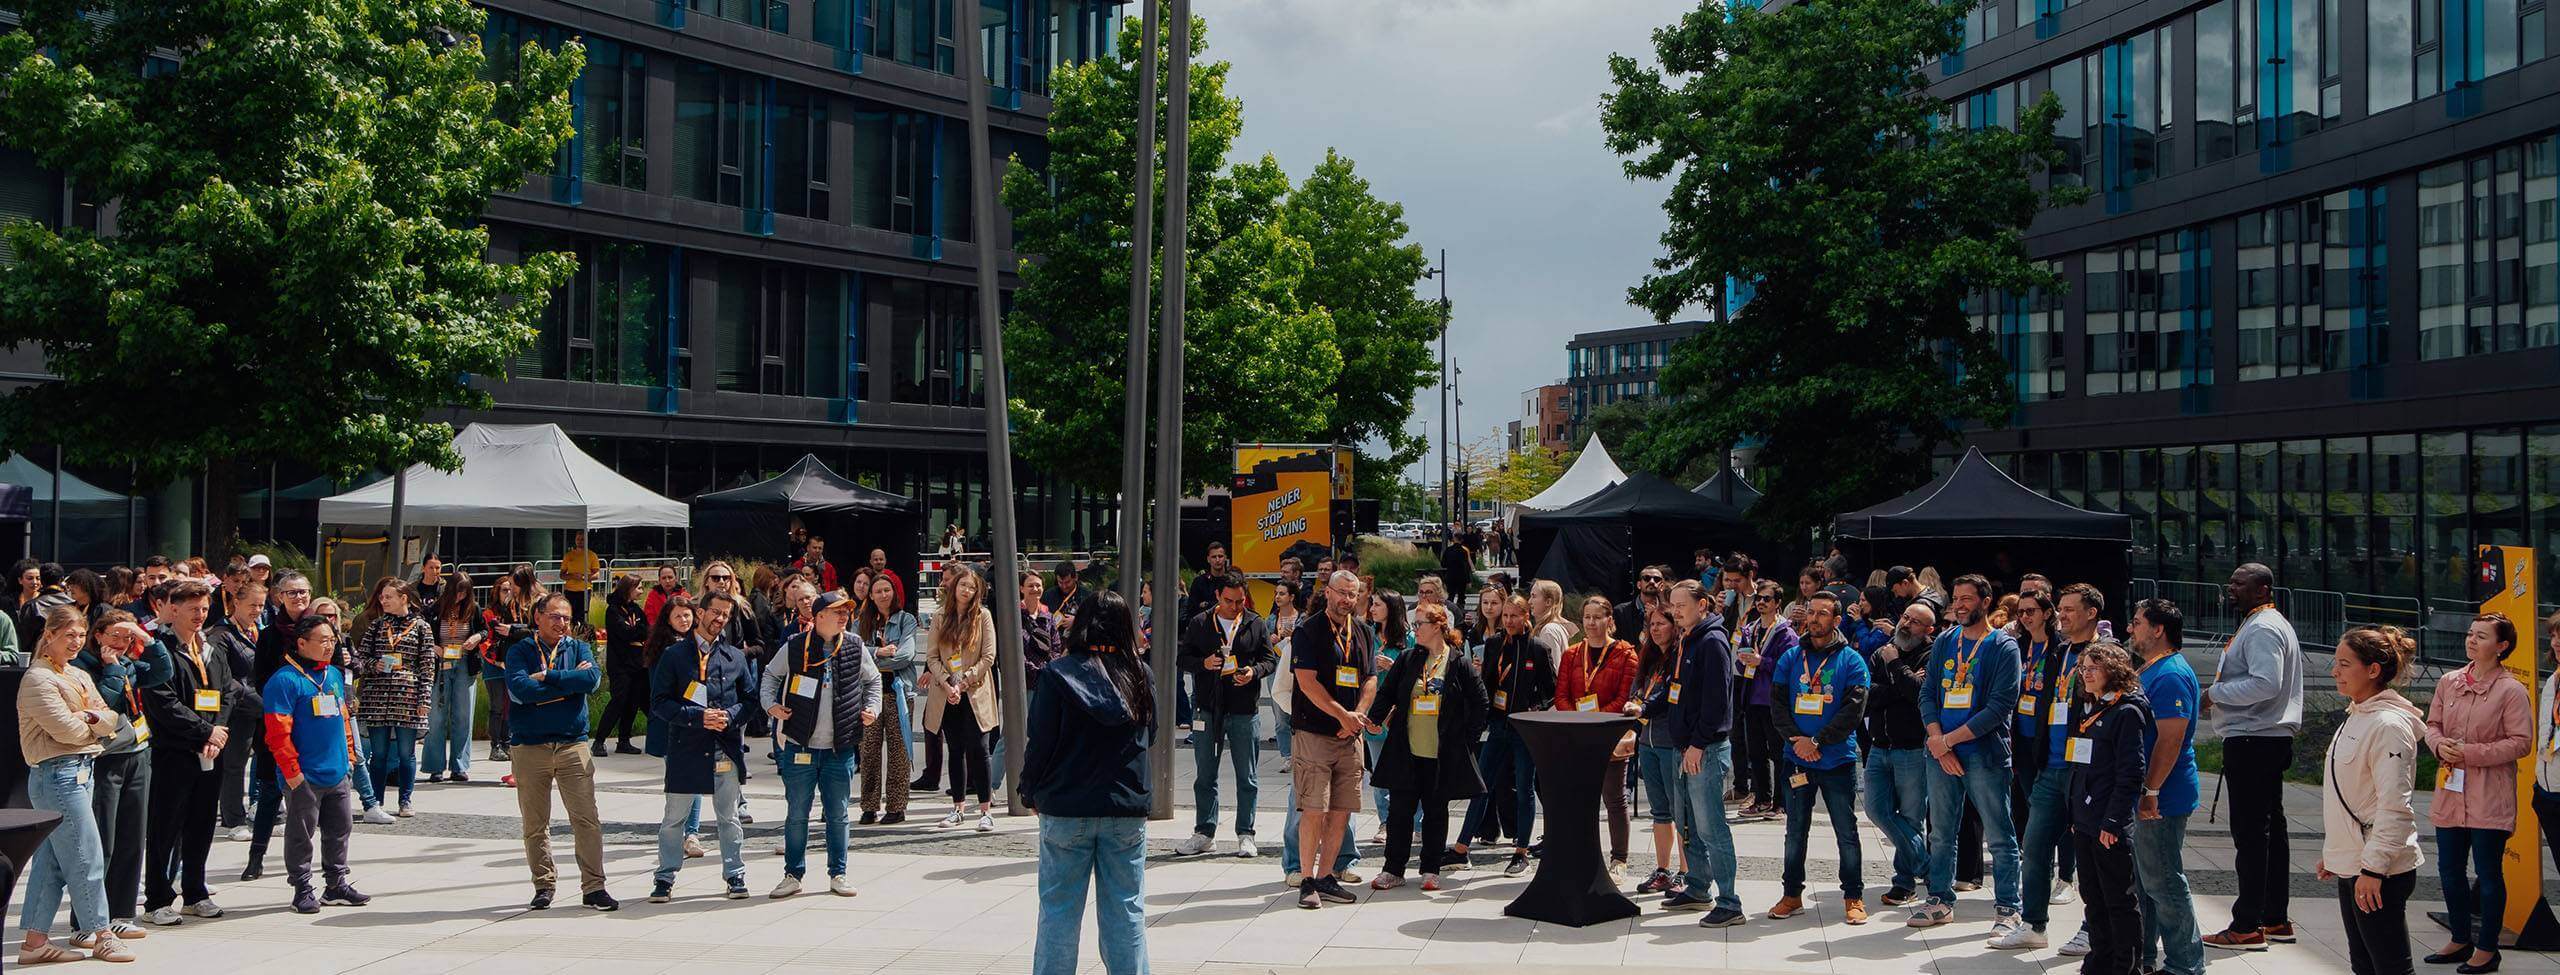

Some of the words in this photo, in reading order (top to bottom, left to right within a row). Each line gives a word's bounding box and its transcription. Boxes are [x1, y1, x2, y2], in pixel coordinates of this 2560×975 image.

[1268, 488, 1301, 513] NEVER
[1257, 511, 1283, 530] STOP
[1264, 517, 1306, 541] PLAYING
